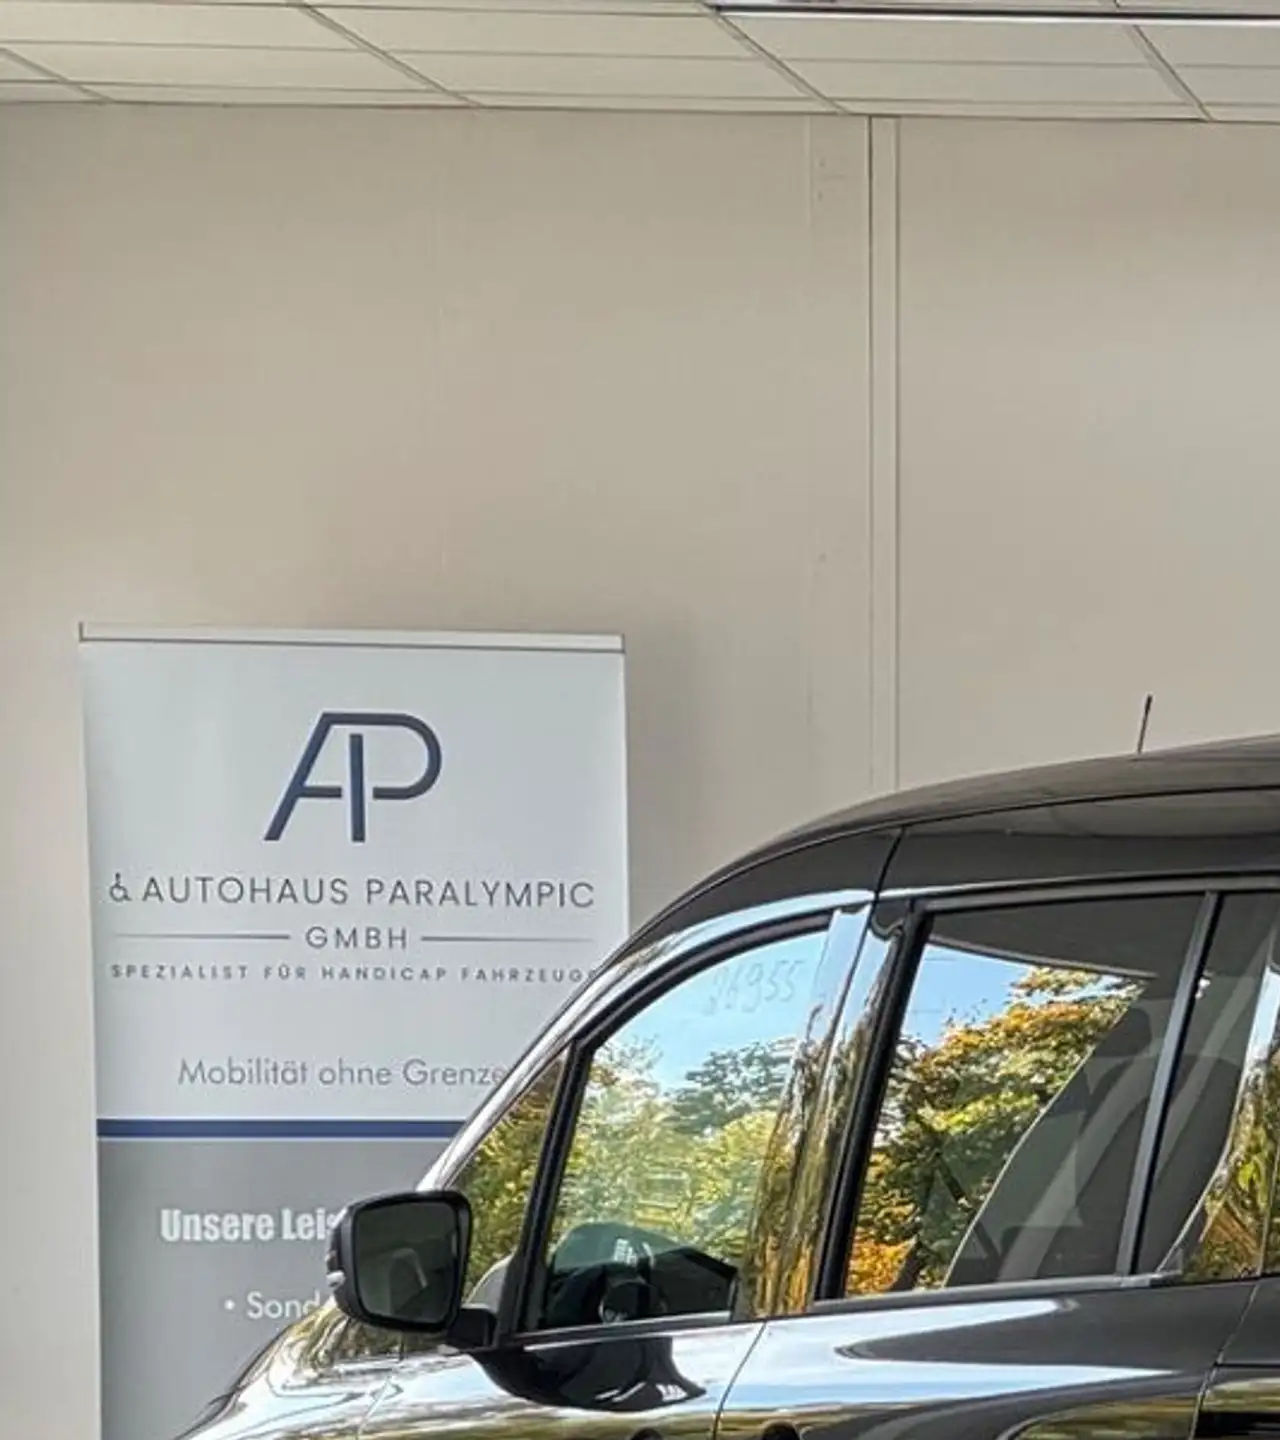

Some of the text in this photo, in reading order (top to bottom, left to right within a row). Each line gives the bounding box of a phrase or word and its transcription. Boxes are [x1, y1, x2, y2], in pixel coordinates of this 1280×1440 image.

[142, 876, 595, 909] AUTOHAUS PARALYMPIC
[305, 926, 408, 951] GMBH
[111, 963, 248, 980] SPEZIALIST
[263, 962, 306, 980] FÜR
[321, 965, 447, 982] HANDICAP
[177, 1057, 308, 1087] Mobilität
[318, 1058, 392, 1087] ohne
[160, 1208, 275, 1242] Unsere
